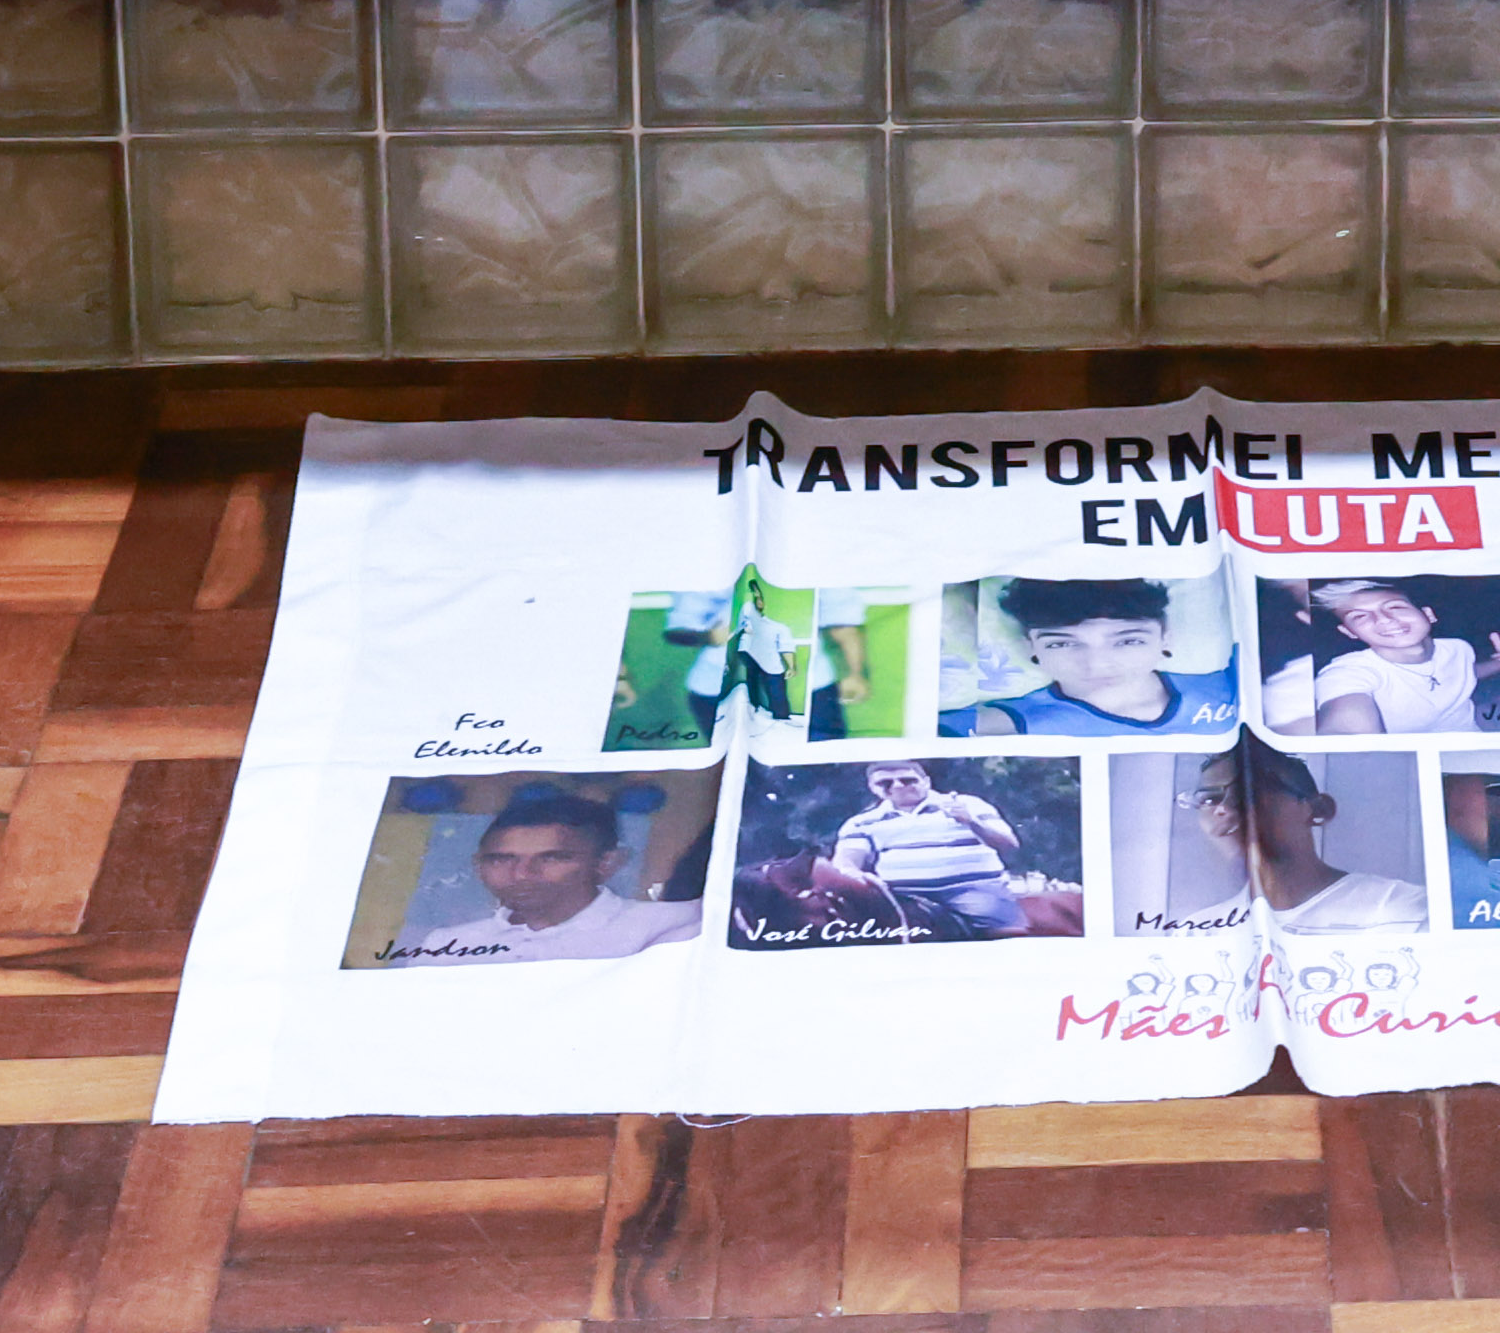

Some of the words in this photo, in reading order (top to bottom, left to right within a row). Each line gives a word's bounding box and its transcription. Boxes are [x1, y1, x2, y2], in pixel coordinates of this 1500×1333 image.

[703, 415, 1302, 495] TRANSFORMEI
[1080, 492, 1208, 546] EM
[1236, 490, 1455, 546] LUTA
[455, 712, 506, 731] Fco
[413, 738, 543, 759] Elenildo
[746, 917, 811, 943] José
[821, 917, 934, 943] Gilvan
[374, 938, 513, 962] Jandson
[1056, 994, 1231, 1041] Mães
